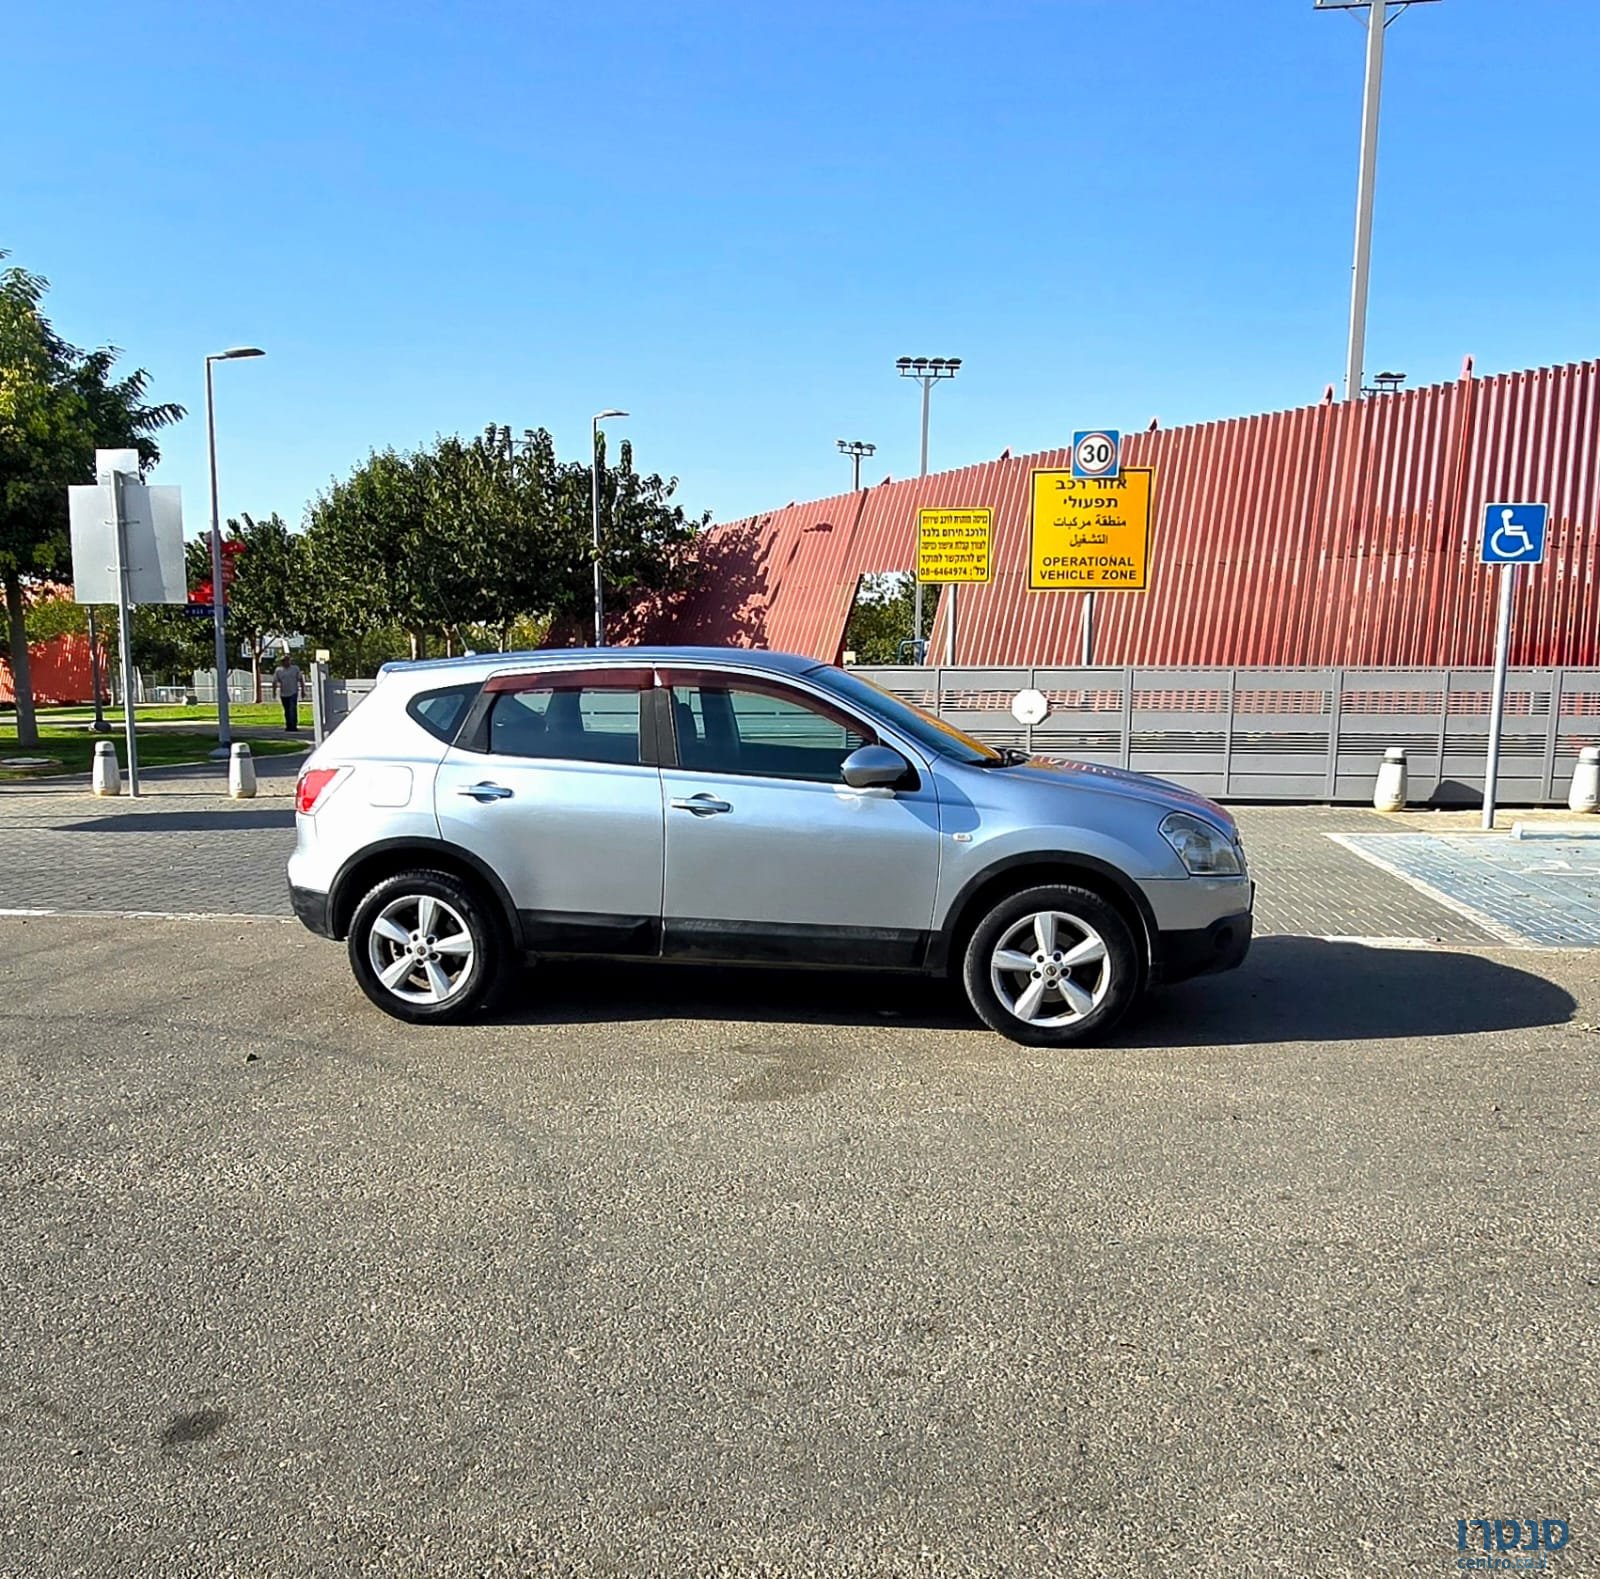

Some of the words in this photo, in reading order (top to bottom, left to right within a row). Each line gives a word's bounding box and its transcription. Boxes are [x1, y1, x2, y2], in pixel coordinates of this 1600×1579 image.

[1082, 444, 1109, 464] 30
[1055, 479, 1086, 490] רכב
[1097, 478, 1127, 490] אזור
[1063, 496, 1118, 509] תפעולי
[1053, 516, 1091, 530] مركبات
[1095, 514, 1127, 527] منطقة
[965, 527, 987, 537] ולרכב
[1069, 533, 1109, 547] التشغيل
[1042, 555, 1135, 567] OPERATIONAL
[1040, 569, 1094, 580] VEHICLE
[1101, 569, 1137, 580] ZONE
